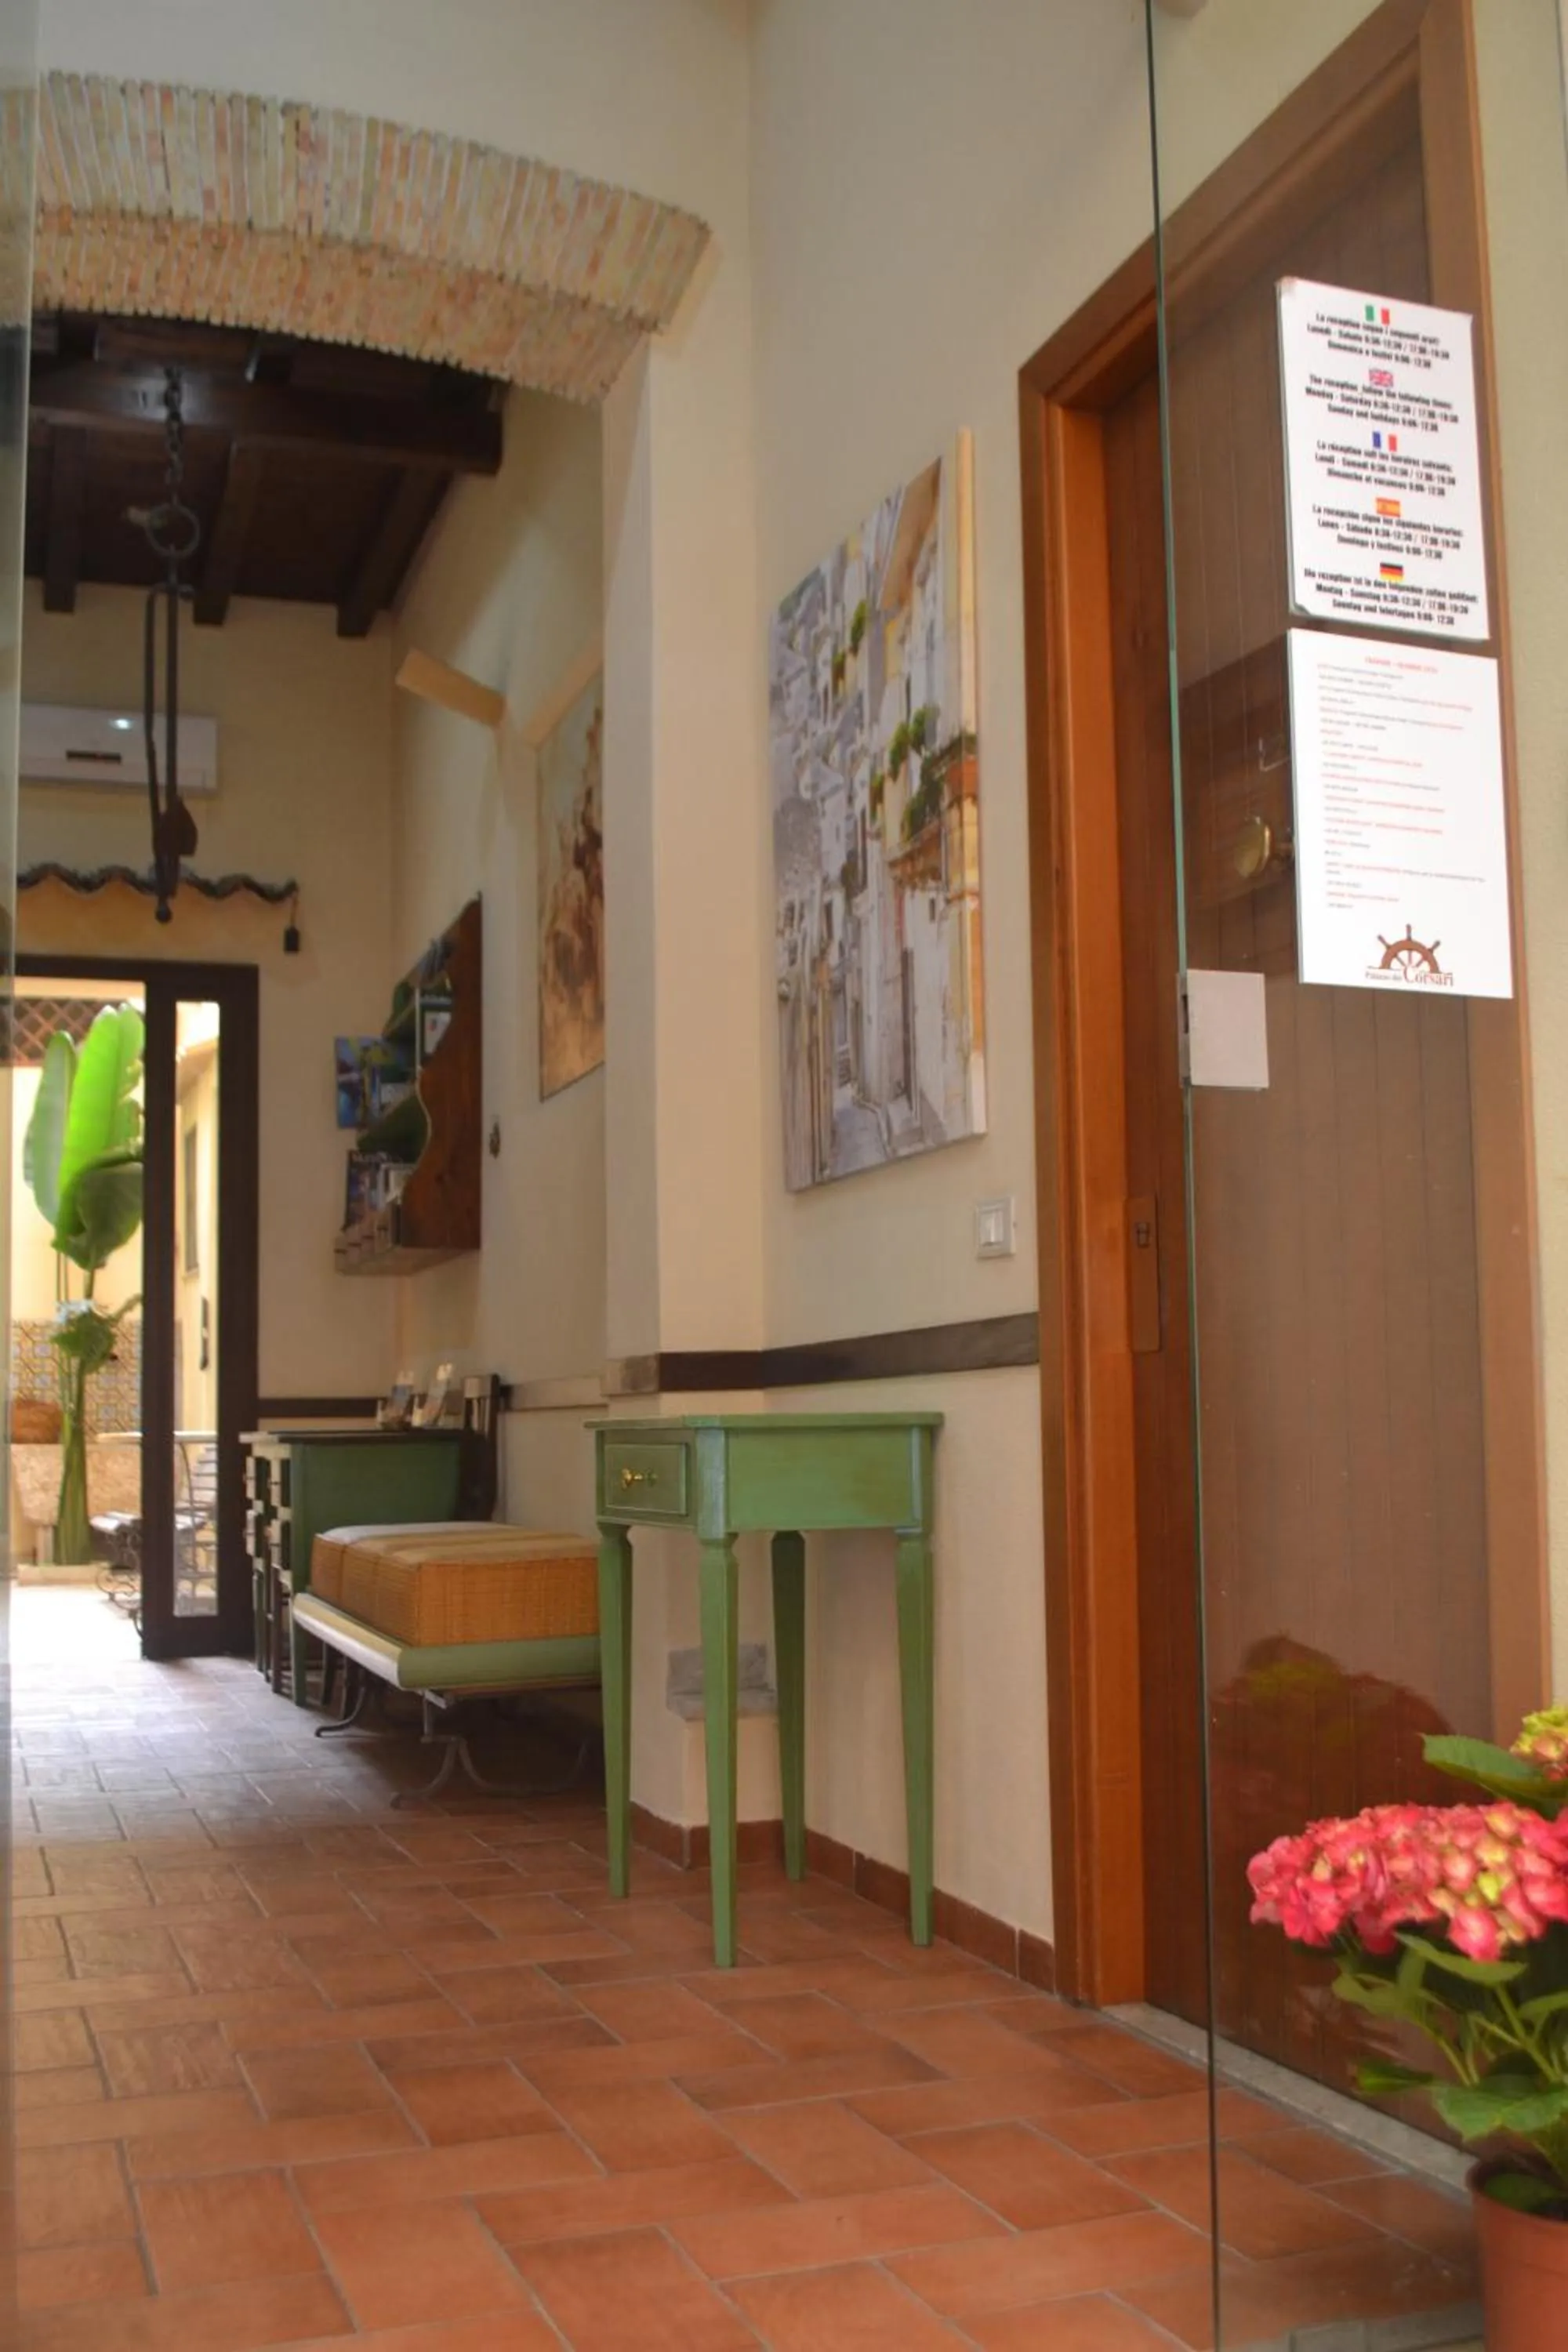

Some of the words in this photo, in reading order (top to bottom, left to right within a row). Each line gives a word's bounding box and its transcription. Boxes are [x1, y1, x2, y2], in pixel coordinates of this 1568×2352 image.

[1305, 387, 1334, 401] Monday
[1340, 393, 1372, 408] Saturday
[1327, 404, 1354, 418] Sunday
[1356, 409, 1369, 419] and
[1317, 518, 1339, 530] Lunes
[1316, 583, 1343, 597] Montag
[1403, 966, 1454, 988] Corsari
